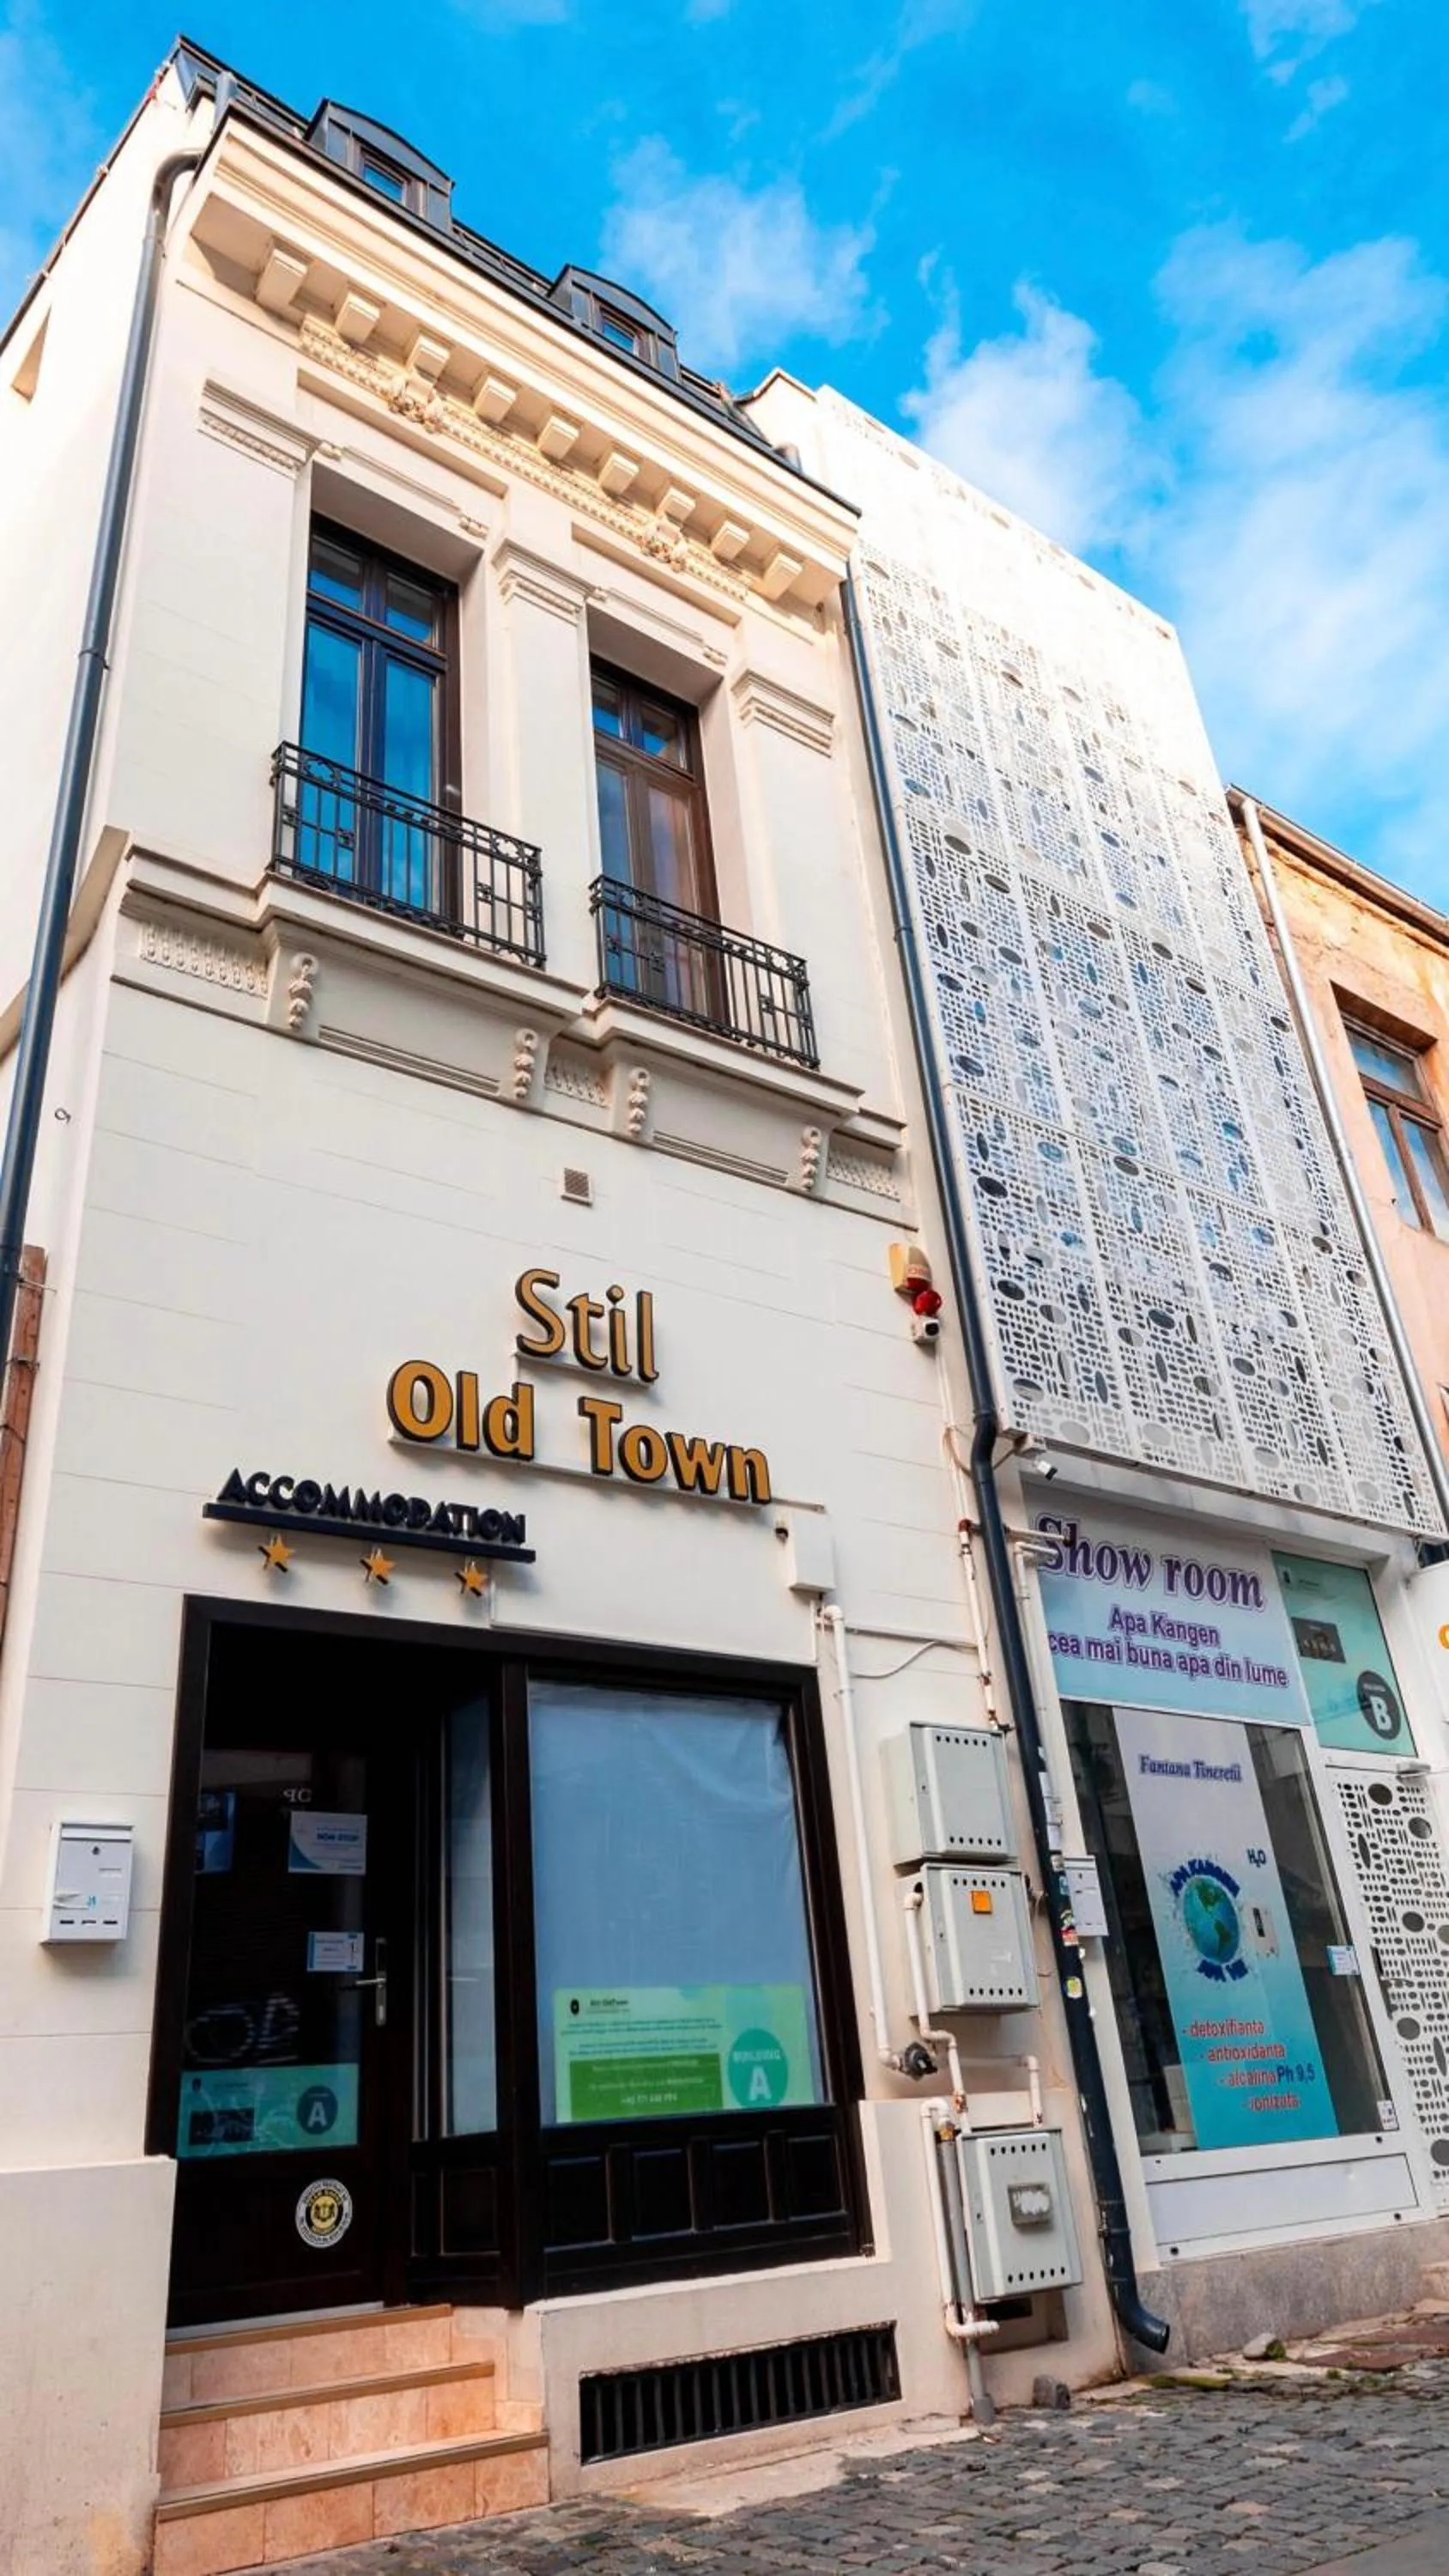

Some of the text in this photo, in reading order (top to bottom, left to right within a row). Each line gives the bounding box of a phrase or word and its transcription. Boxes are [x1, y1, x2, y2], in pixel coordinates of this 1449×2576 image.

[515, 1267, 659, 1382] Stil
[386, 1359, 771, 1504] Old Town
[215, 1467, 526, 1545] ACCOMMODATION
[1036, 1514, 1265, 1612] Show room
[1110, 1605, 1220, 1648] Apa Kangen
[1048, 1633, 1082, 1656] cea
[1086, 1637, 1122, 1662] mai
[1126, 1641, 1173, 1671] buna
[1177, 1653, 1210, 1679] apa
[1214, 1655, 1241, 1680] din
[1371, 1695, 1392, 1731] B
[1139, 1754, 1191, 1778] Fantana
[749, 2065, 772, 2101] A
[1276, 2065, 1294, 2083] Ph
[307, 2100, 327, 2128] A
